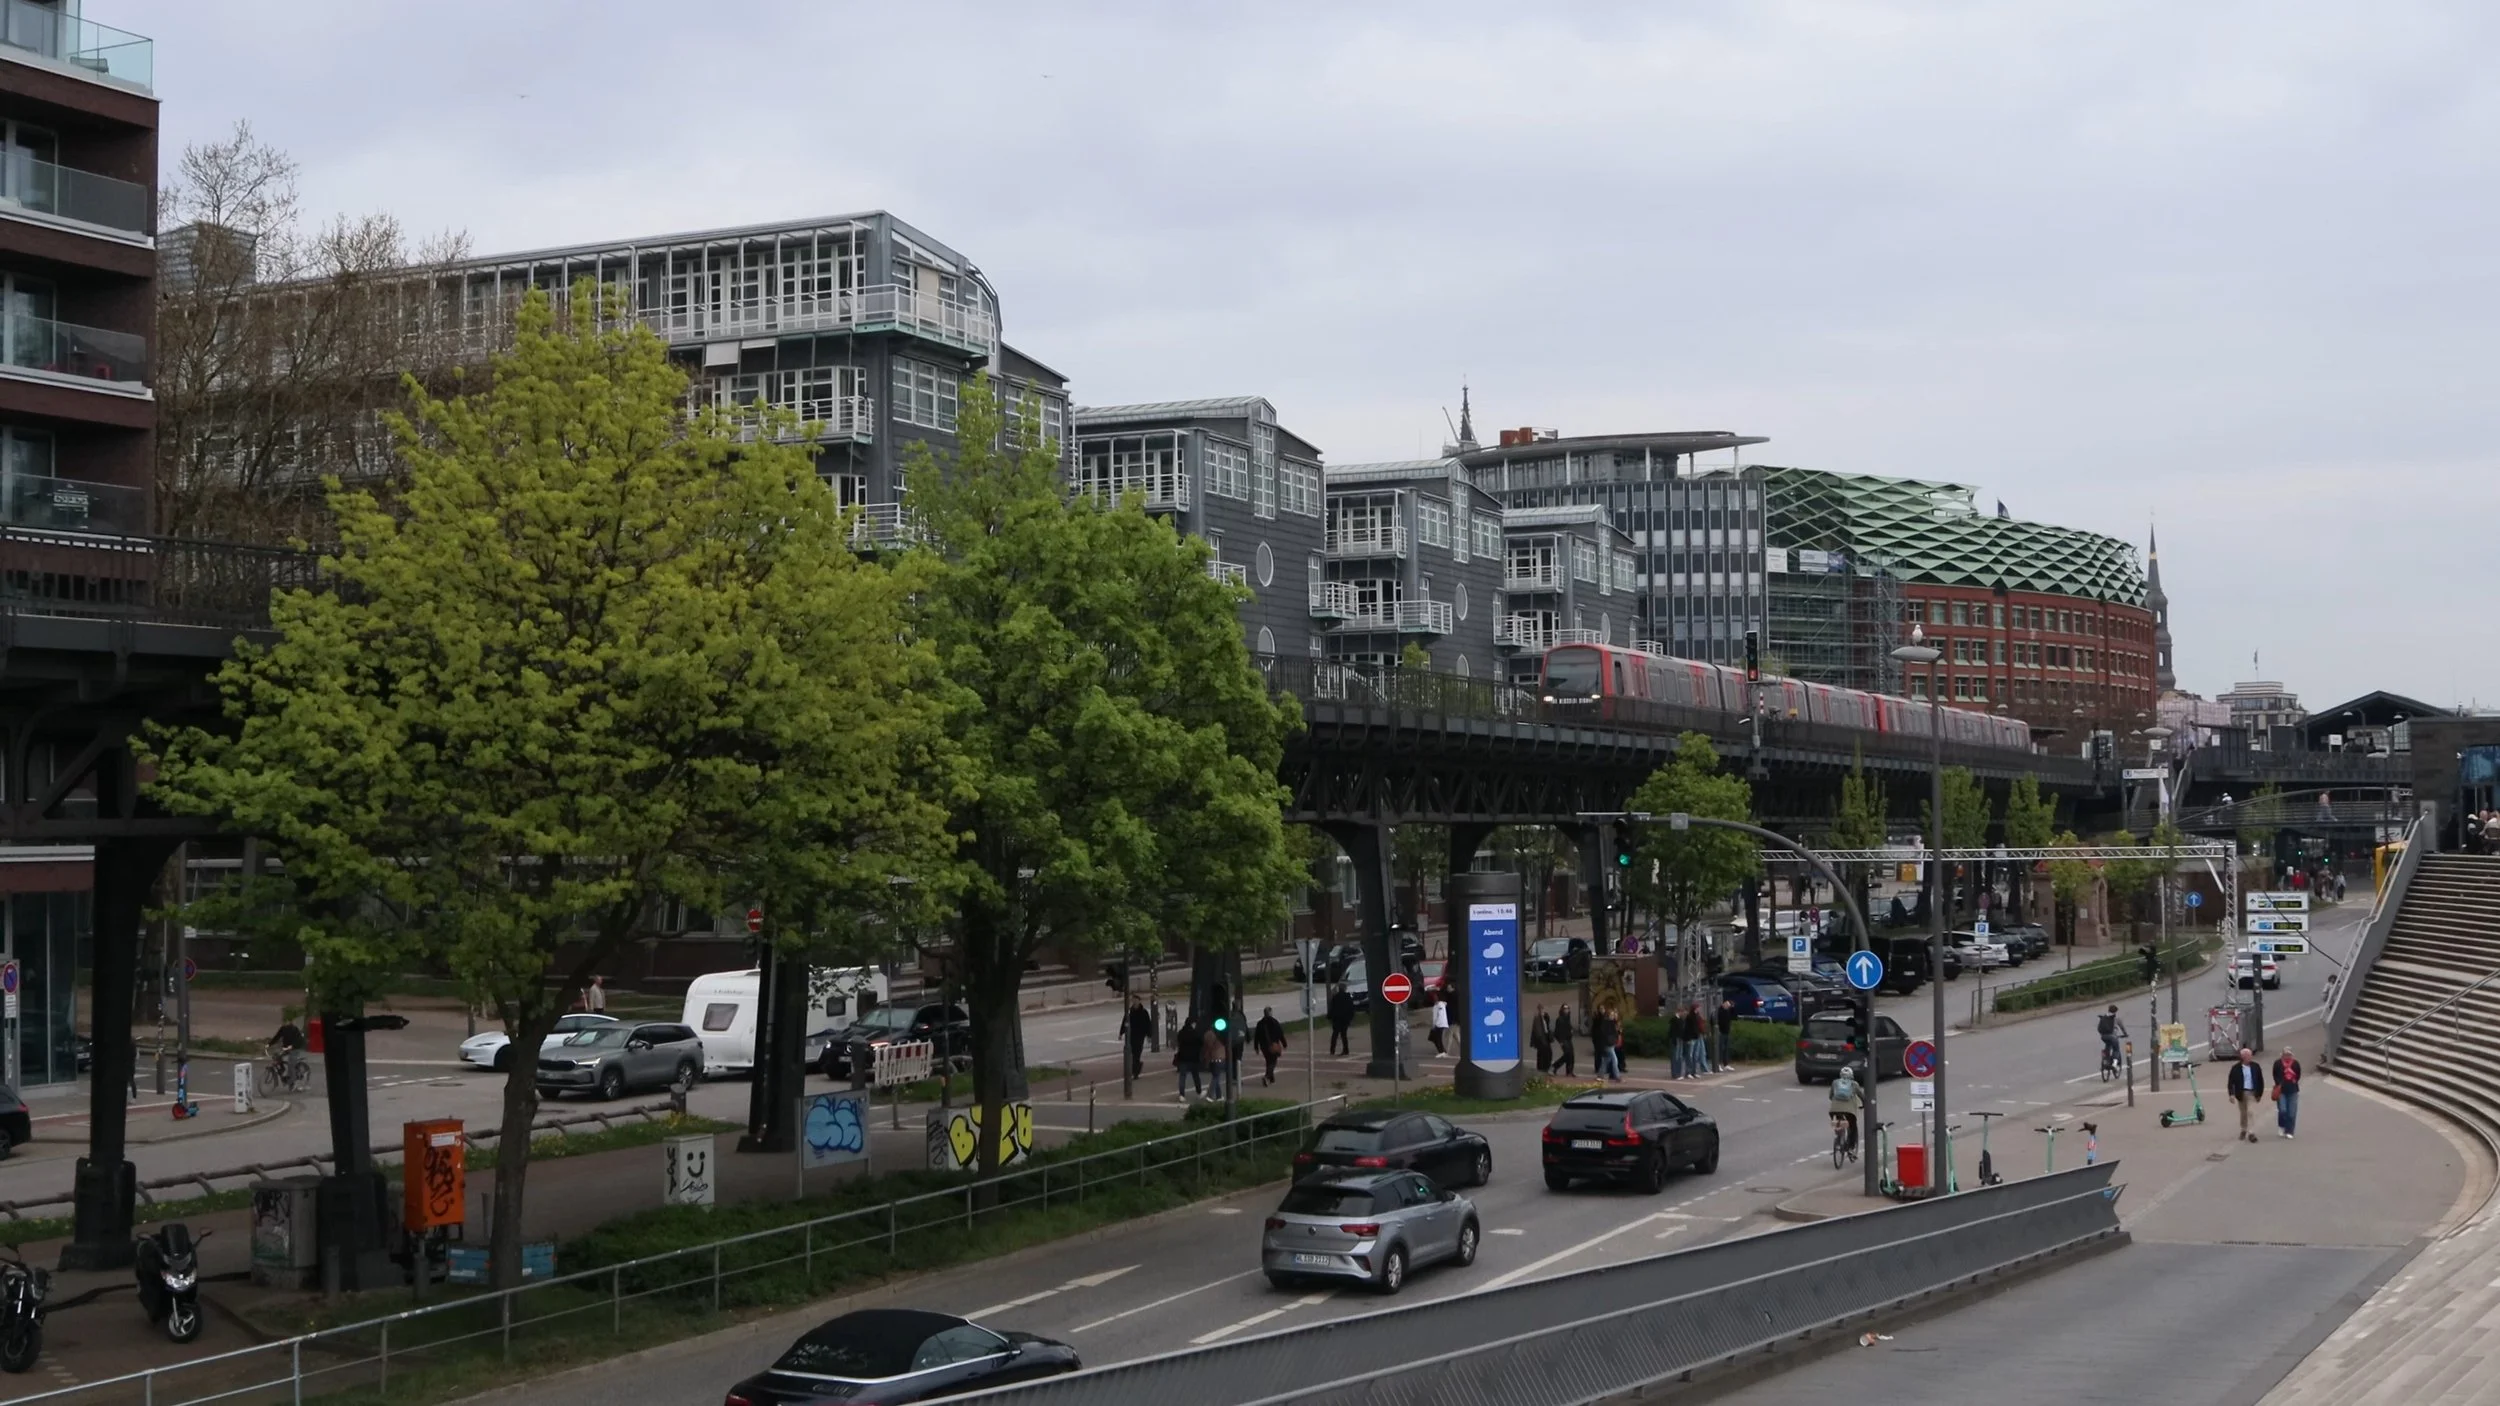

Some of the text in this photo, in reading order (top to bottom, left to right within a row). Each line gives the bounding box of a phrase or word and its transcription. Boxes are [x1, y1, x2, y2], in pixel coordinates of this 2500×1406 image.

[1795, 939, 1803, 950] P
[1485, 966, 1503, 976] 14°
[1485, 996, 1504, 1004] Nacht
[1486, 1033, 1503, 1043] 11°
